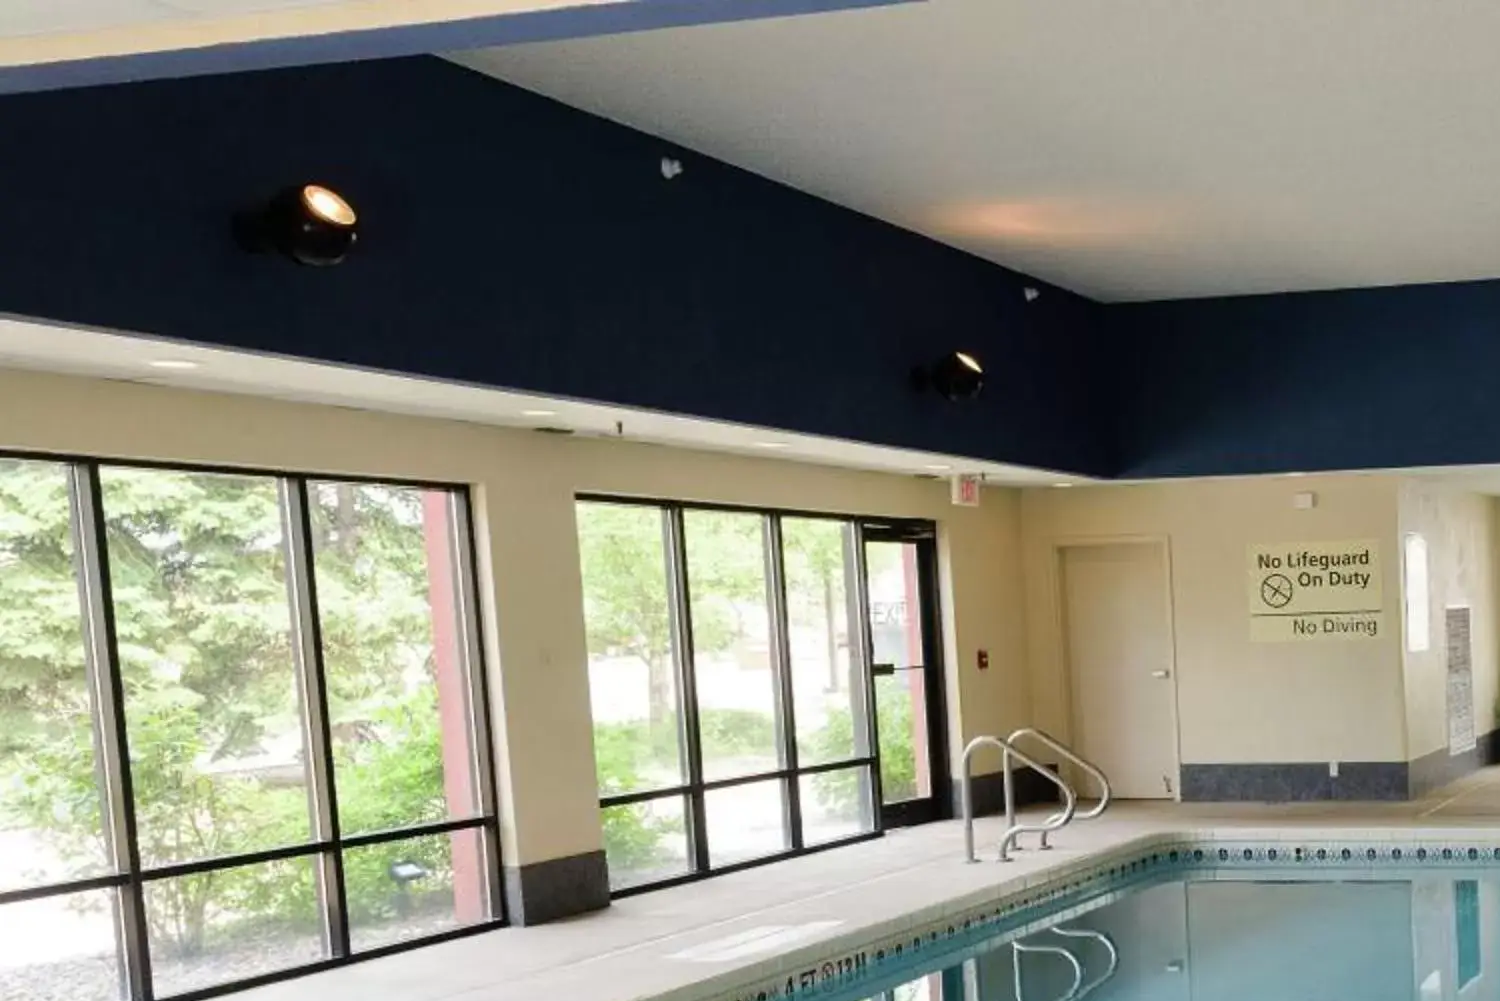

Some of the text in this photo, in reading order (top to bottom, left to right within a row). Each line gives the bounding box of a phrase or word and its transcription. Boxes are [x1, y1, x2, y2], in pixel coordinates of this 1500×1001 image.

[1257, 549, 1369, 571] No Lifeguard
[1297, 571, 1370, 589] On Duty
[1293, 617, 1377, 637] No Diving
